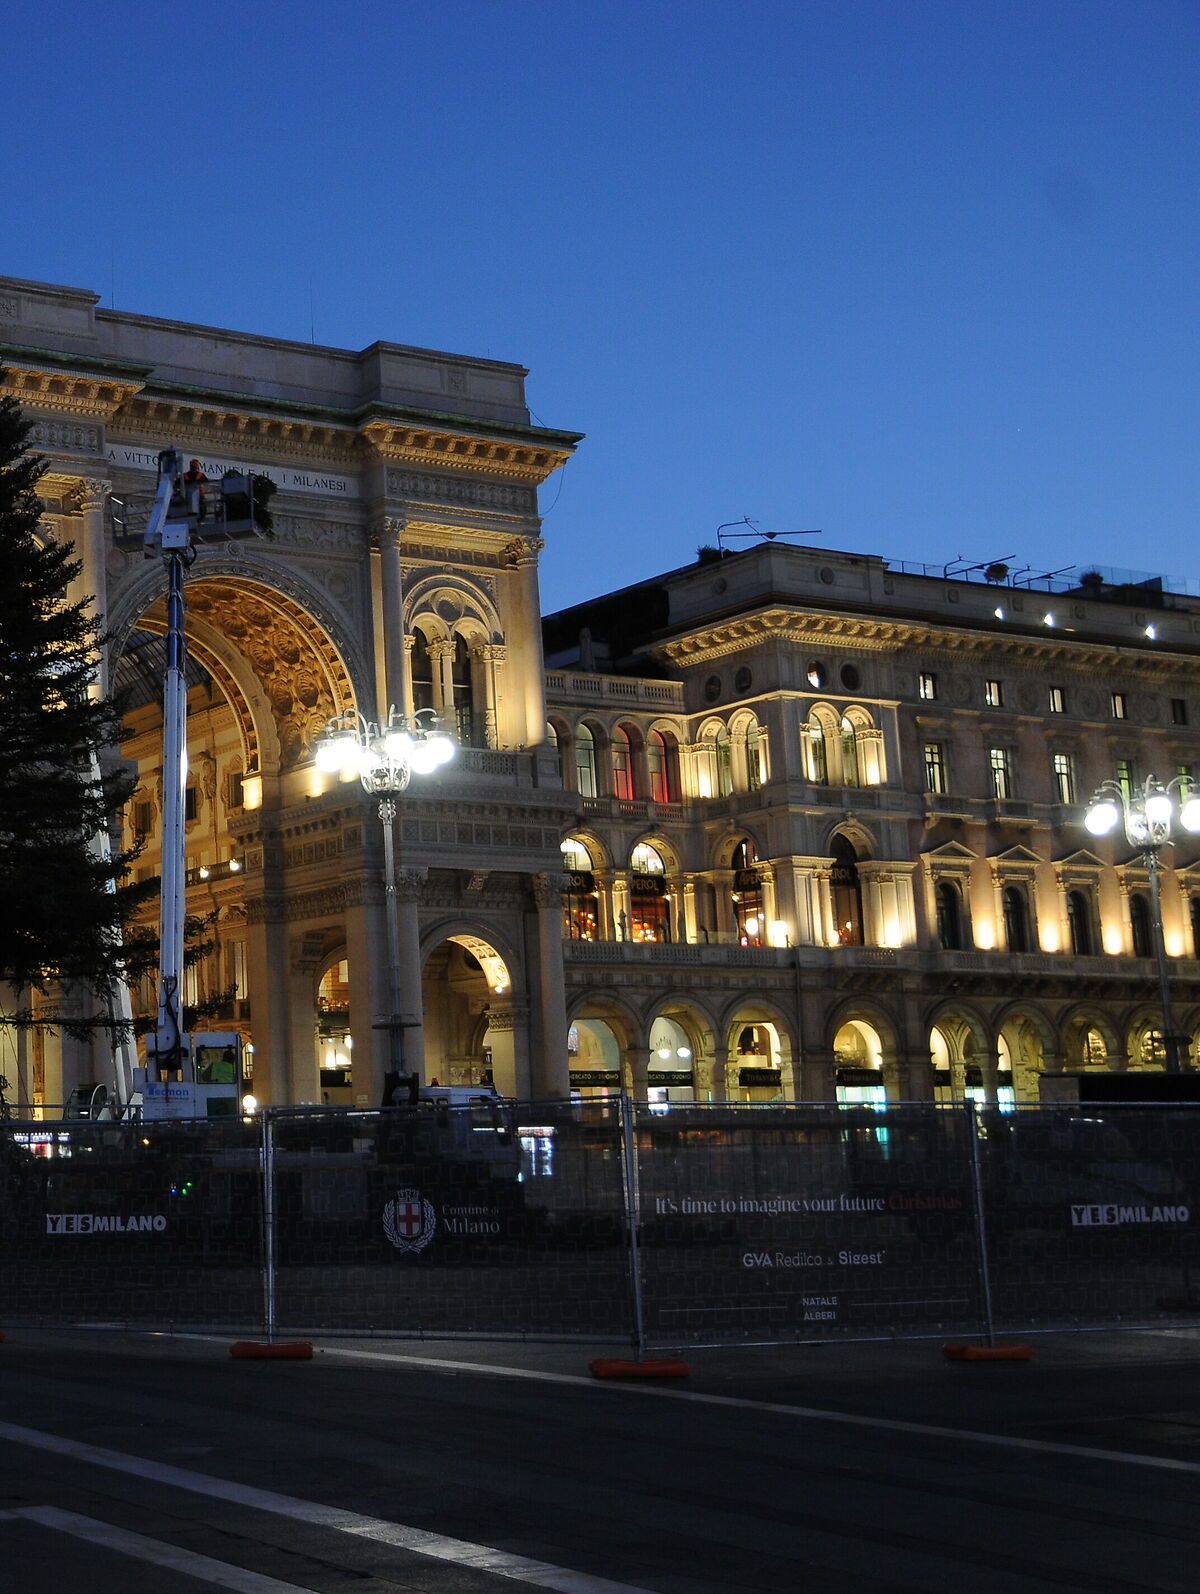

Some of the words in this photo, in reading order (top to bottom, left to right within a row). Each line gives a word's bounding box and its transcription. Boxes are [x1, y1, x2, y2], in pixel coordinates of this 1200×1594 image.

[108, 450, 116, 460] A
[293, 475, 346, 491] MILANESI
[442, 1204, 489, 1215] Comune
[655, 1198, 678, 1214] It's
[682, 1196, 717, 1213] time
[720, 1198, 736, 1213] to
[739, 1196, 800, 1217] imagine
[802, 1199, 837, 1217] your
[840, 1193, 885, 1211] future
[46, 1213, 167, 1234] YESMILANO
[1071, 1204, 1190, 1226] YESMILANO
[443, 1217, 500, 1233] Milano
[742, 1252, 773, 1267] GVA
[775, 1251, 822, 1266] Redilco
[838, 1250, 883, 1265] Sigest
[802, 1296, 838, 1306] NATALE
[803, 1311, 836, 1321] ALBERI
